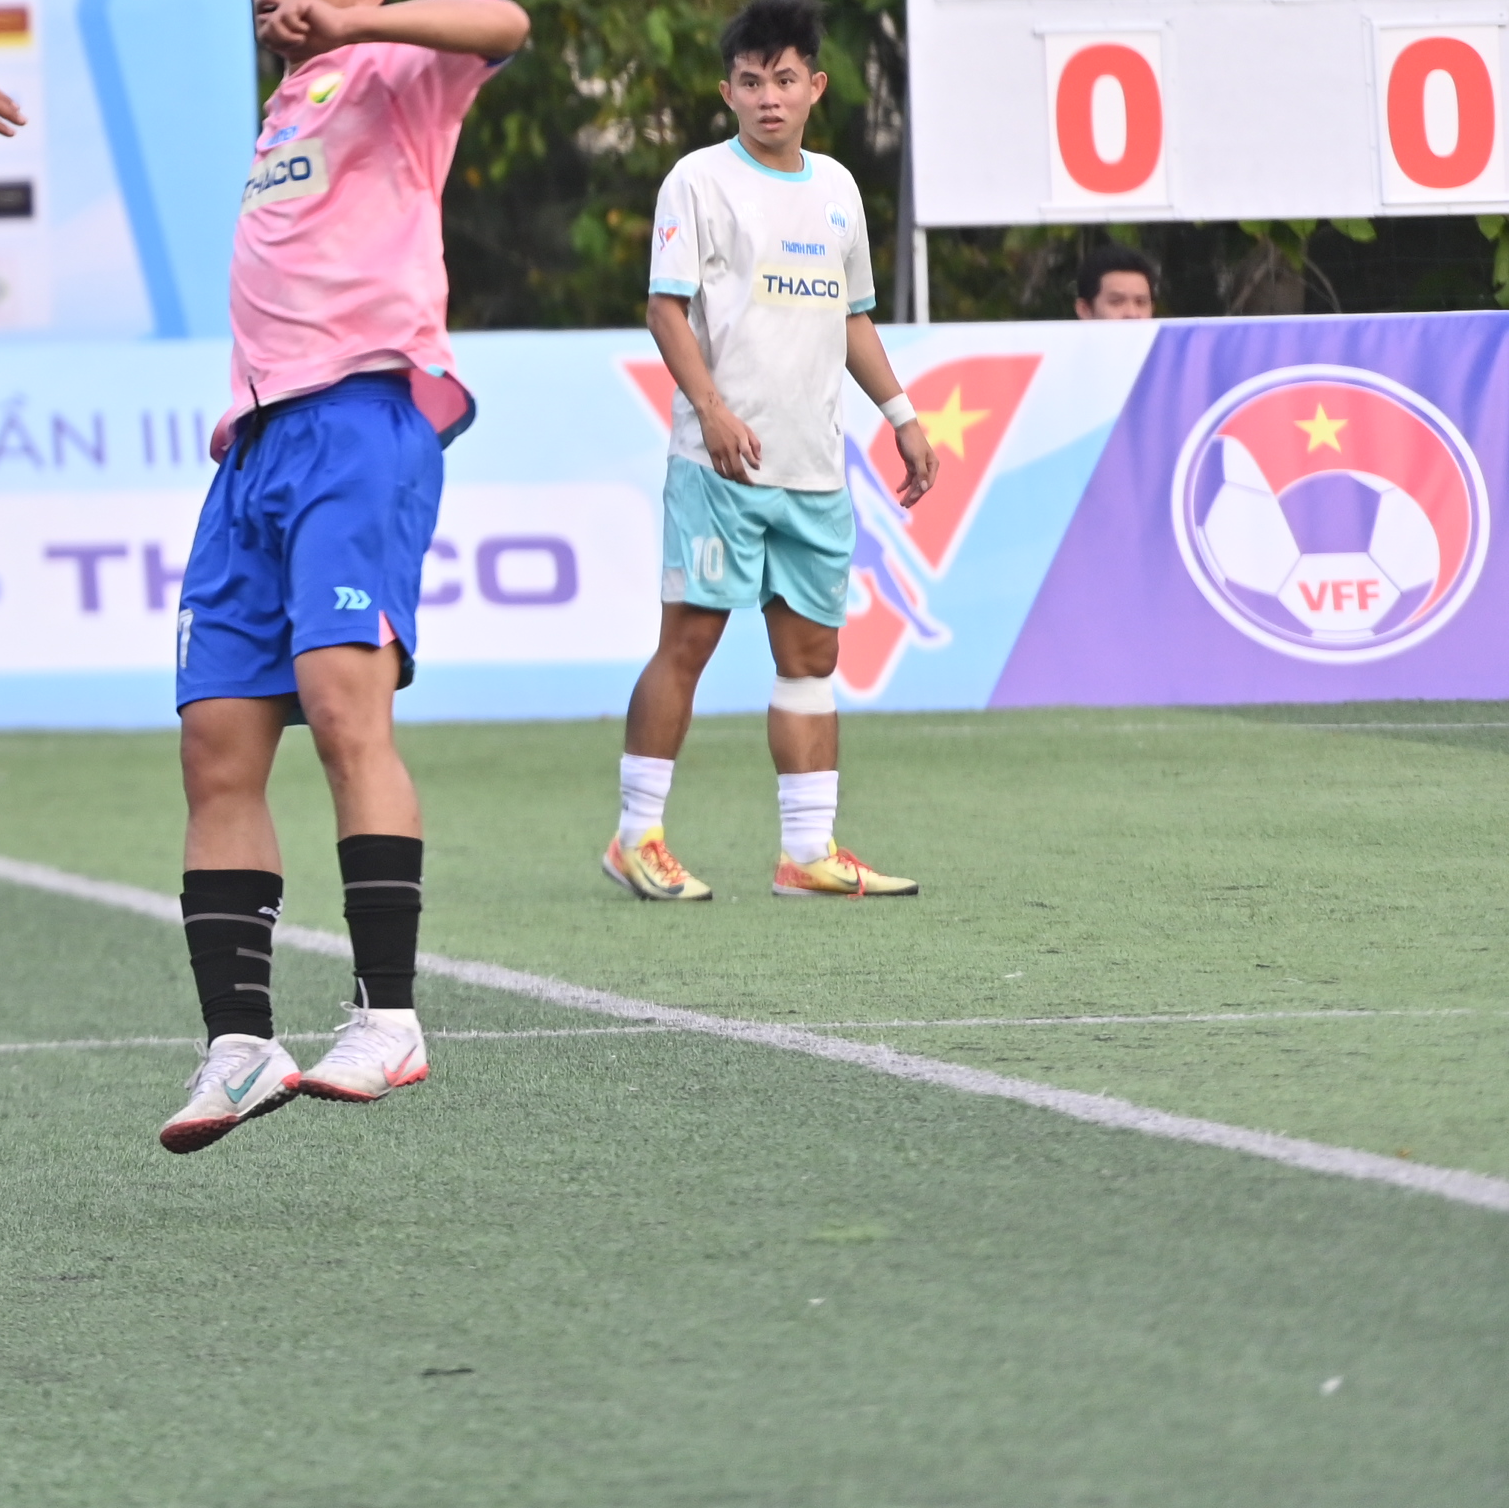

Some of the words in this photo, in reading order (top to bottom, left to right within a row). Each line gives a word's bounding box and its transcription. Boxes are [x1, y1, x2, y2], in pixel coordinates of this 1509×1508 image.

[1055, 41, 1163, 194] 0
[1386, 35, 1496, 190] 0
[762, 273, 840, 299] THACO
[691, 535, 725, 583] 10
[1297, 579, 1382, 613] VFF
